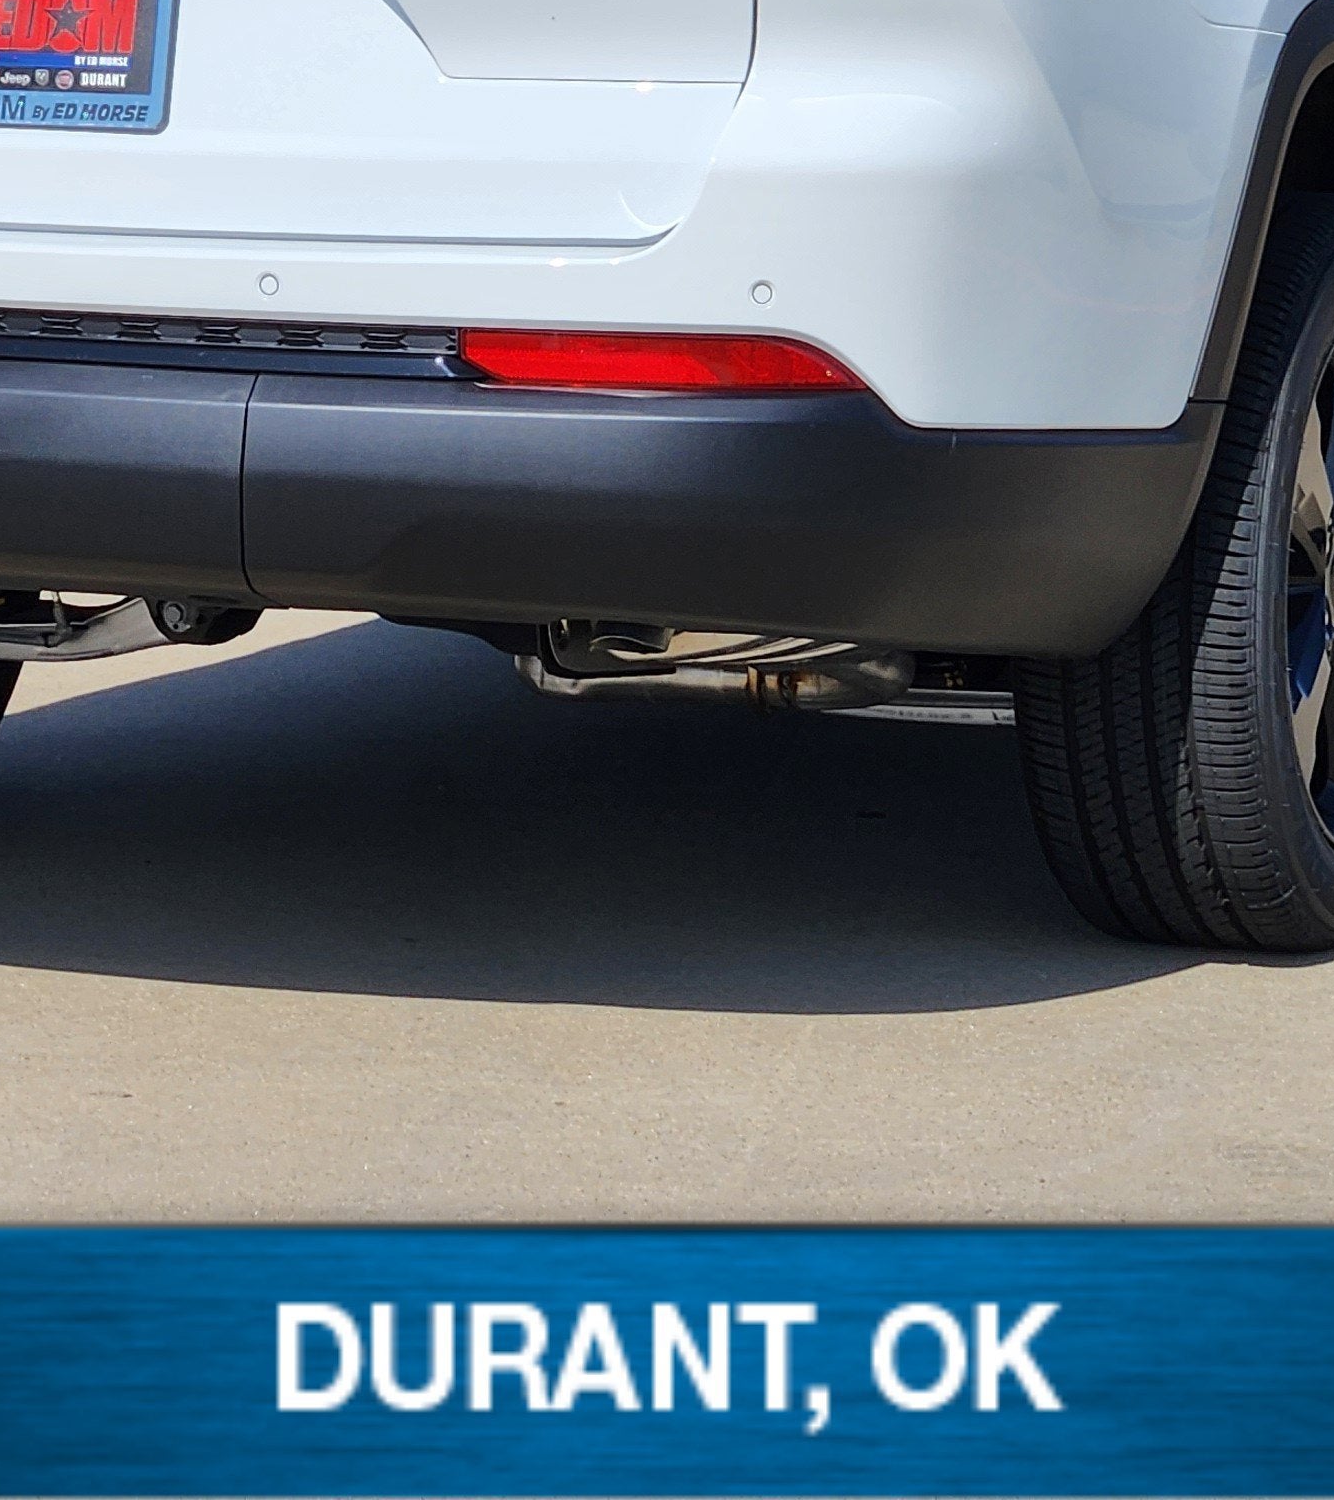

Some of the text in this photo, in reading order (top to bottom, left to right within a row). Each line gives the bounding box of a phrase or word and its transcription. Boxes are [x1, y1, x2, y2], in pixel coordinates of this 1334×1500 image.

[0, 71, 31, 87] Jeep
[79, 72, 128, 88] DURANT
[32, 104, 50, 120] By
[52, 102, 77, 120] ED
[81, 102, 149, 123] MORSE
